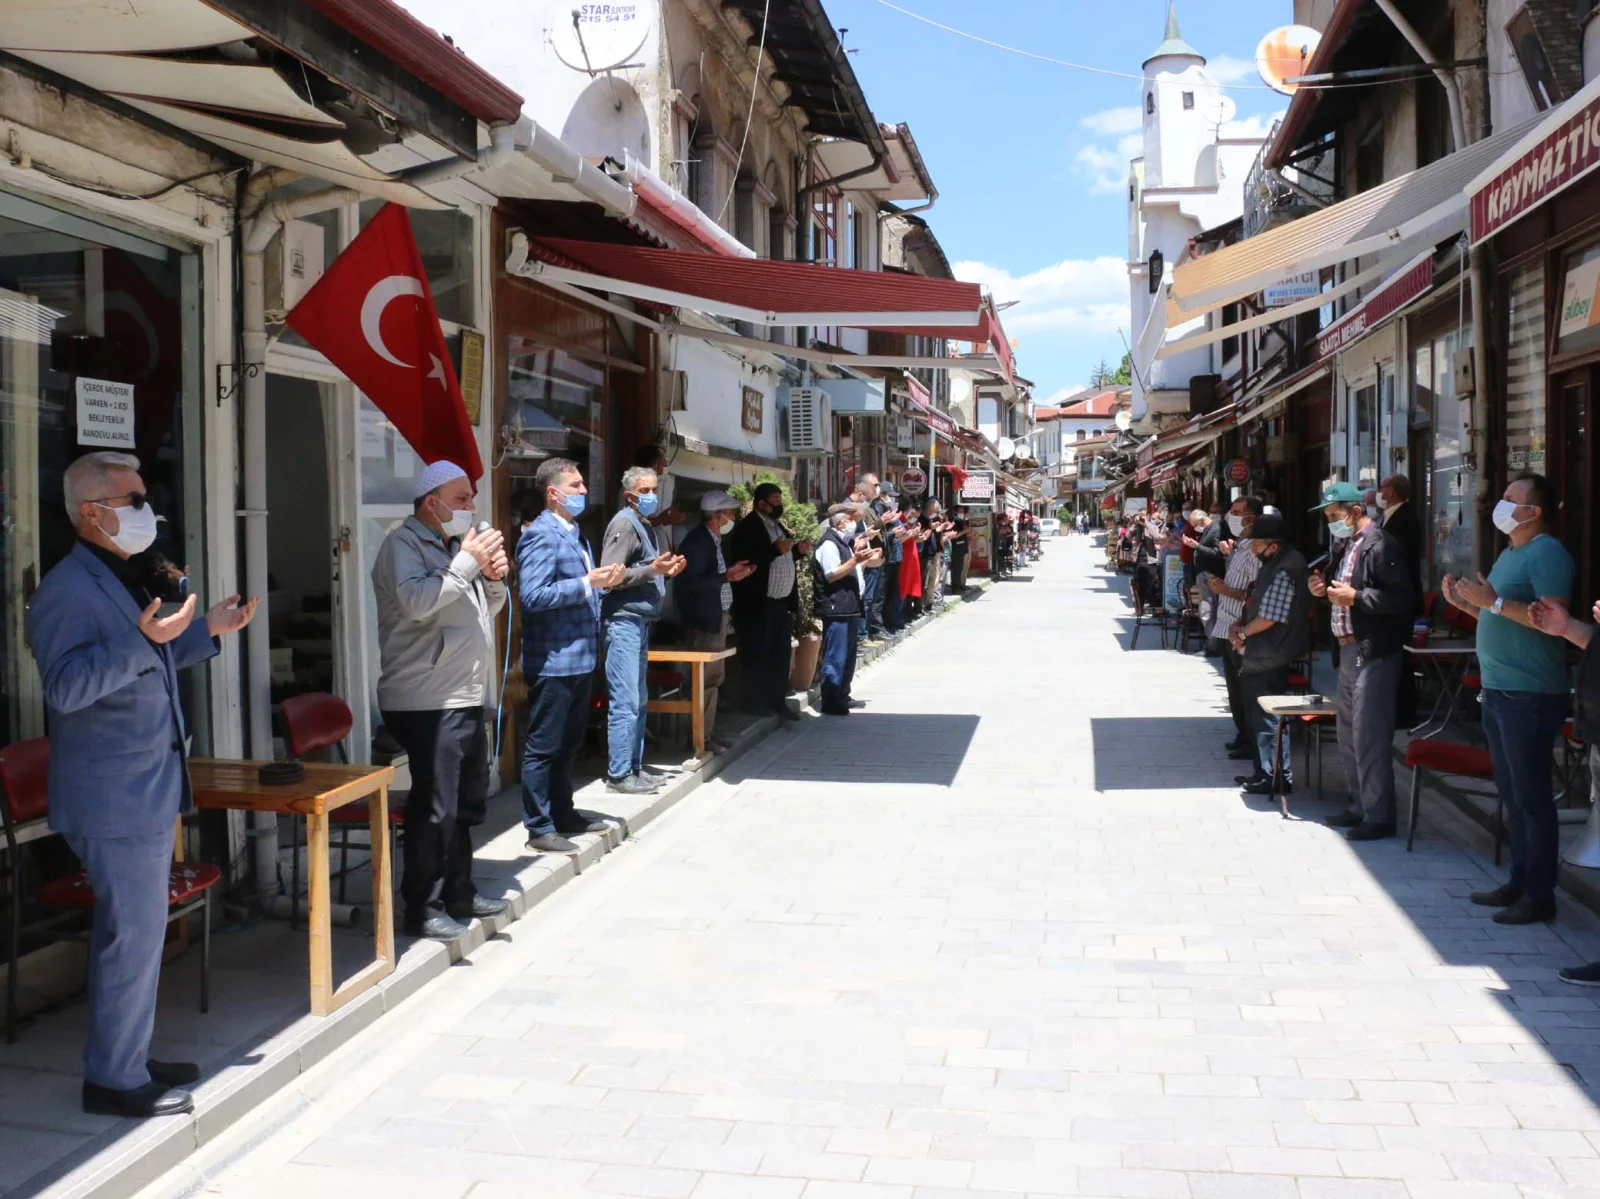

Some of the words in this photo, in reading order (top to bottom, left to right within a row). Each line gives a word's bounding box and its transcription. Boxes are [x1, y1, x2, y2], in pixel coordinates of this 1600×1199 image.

[582, 5, 610, 15] STAR
[84, 398, 108, 408] VARKEN
[83, 429, 110, 439] RANDEVU
